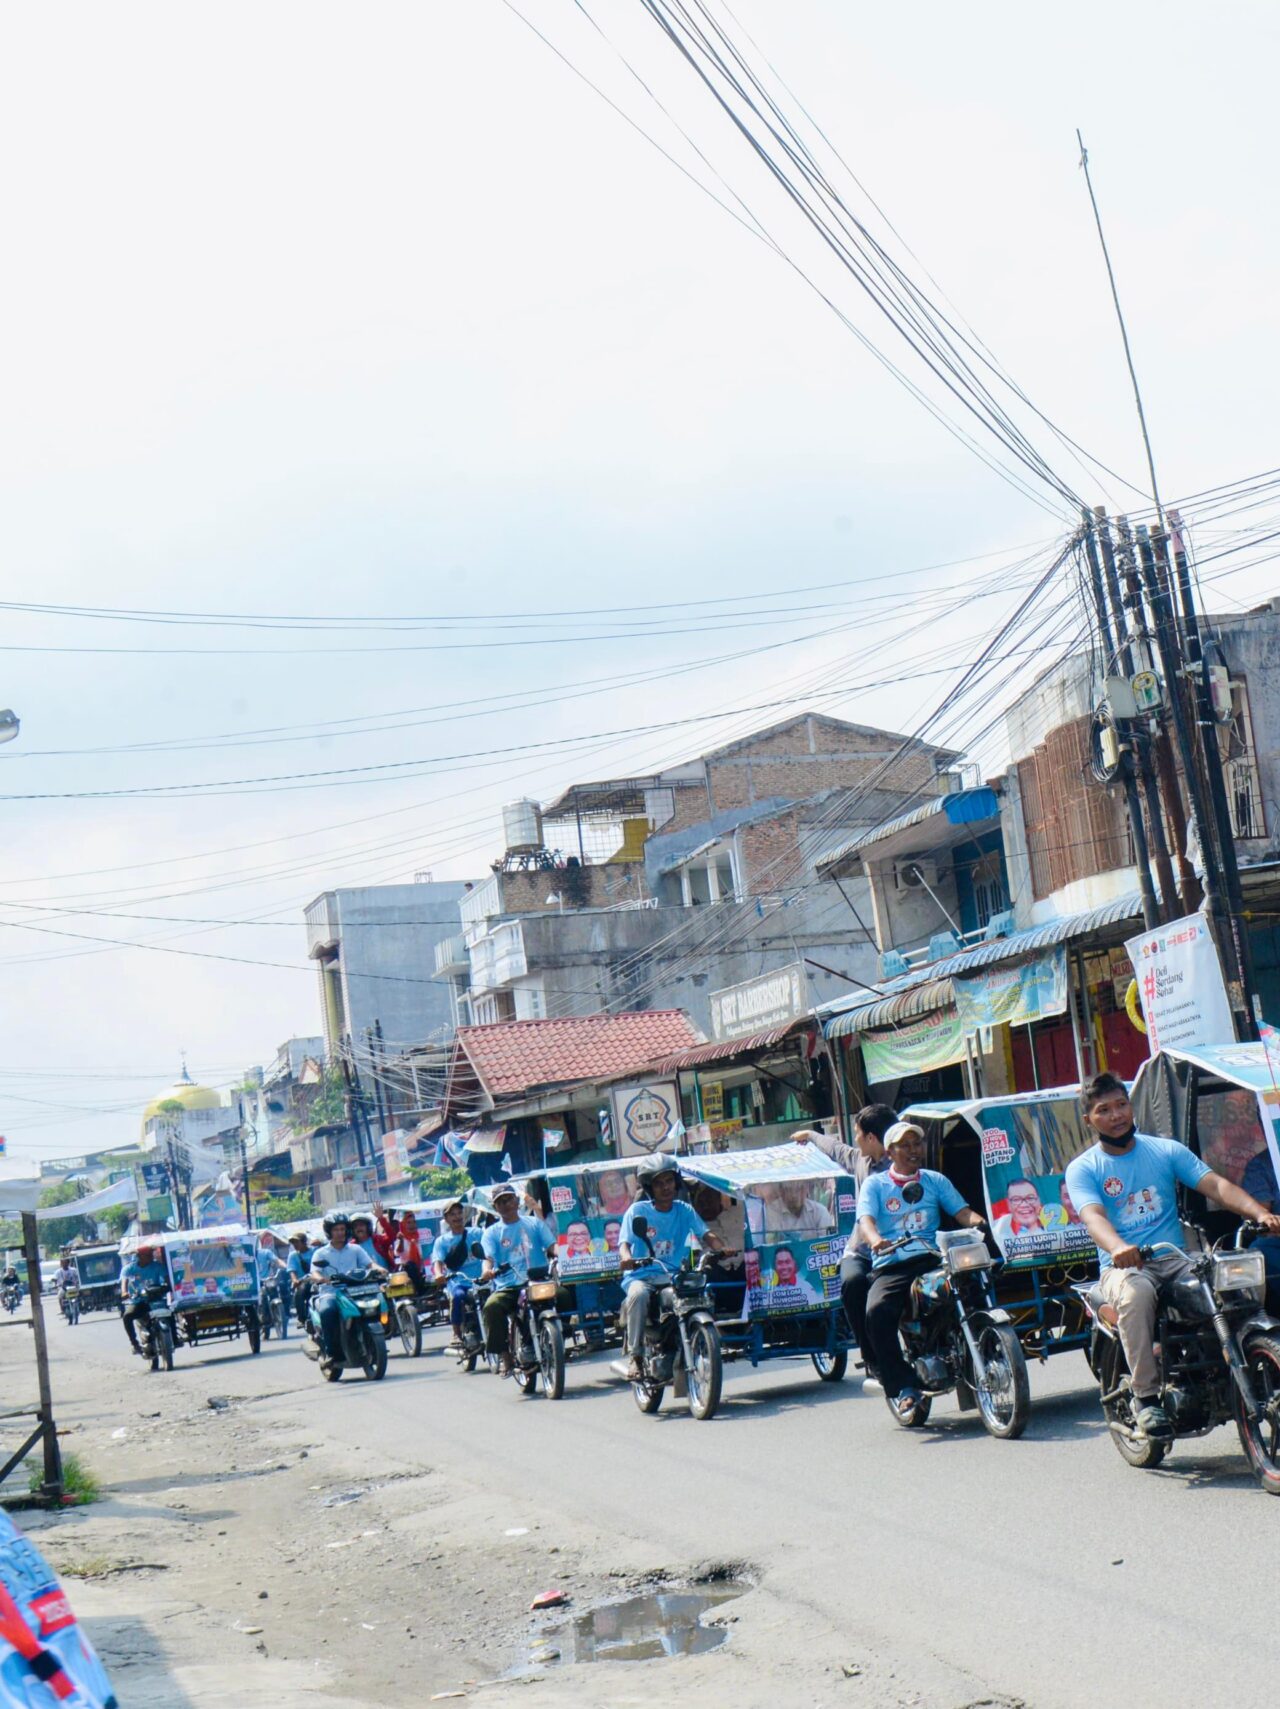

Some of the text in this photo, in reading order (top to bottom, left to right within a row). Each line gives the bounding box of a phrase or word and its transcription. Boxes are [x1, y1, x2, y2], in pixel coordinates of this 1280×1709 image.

[984, 1141, 1006, 1151] 2024
[1033, 1234, 1057, 1243] LUDIN
[1064, 1229, 1081, 1239] LOM
